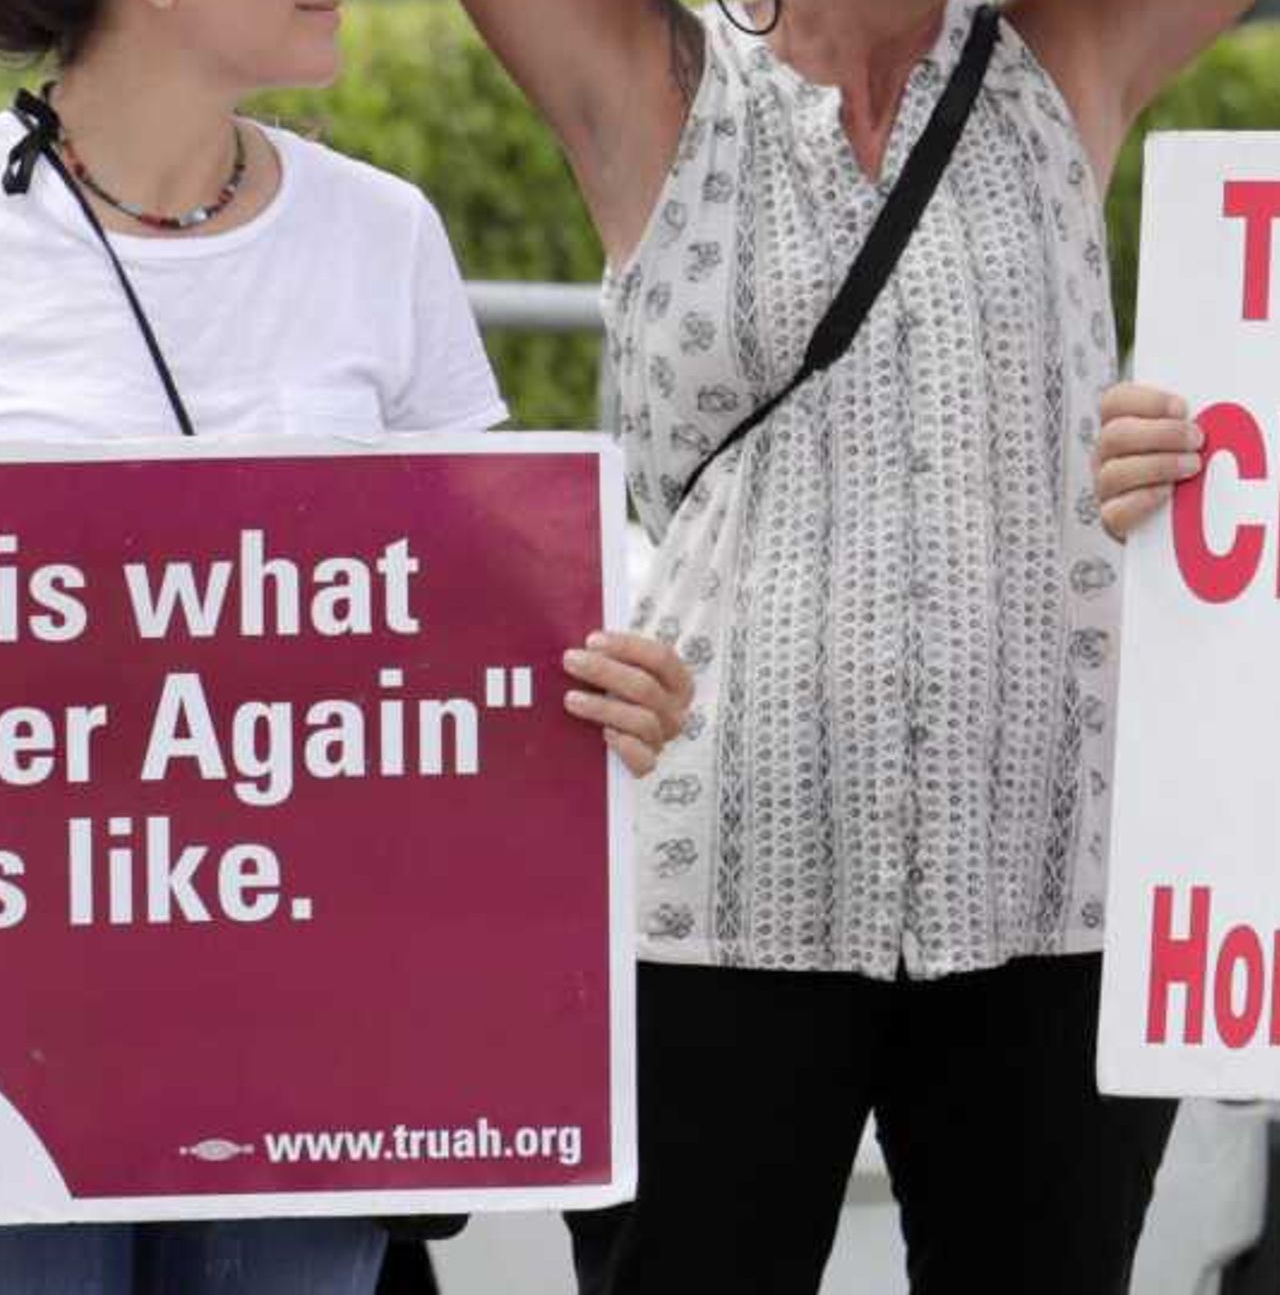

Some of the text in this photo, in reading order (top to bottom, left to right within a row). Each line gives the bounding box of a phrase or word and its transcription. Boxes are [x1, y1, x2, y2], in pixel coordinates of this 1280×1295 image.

[125, 530, 418, 637] what
[142, 669, 530, 804] Again"
[71, 817, 310, 923] like.
[264, 1118, 581, 1165] www.truah.org
